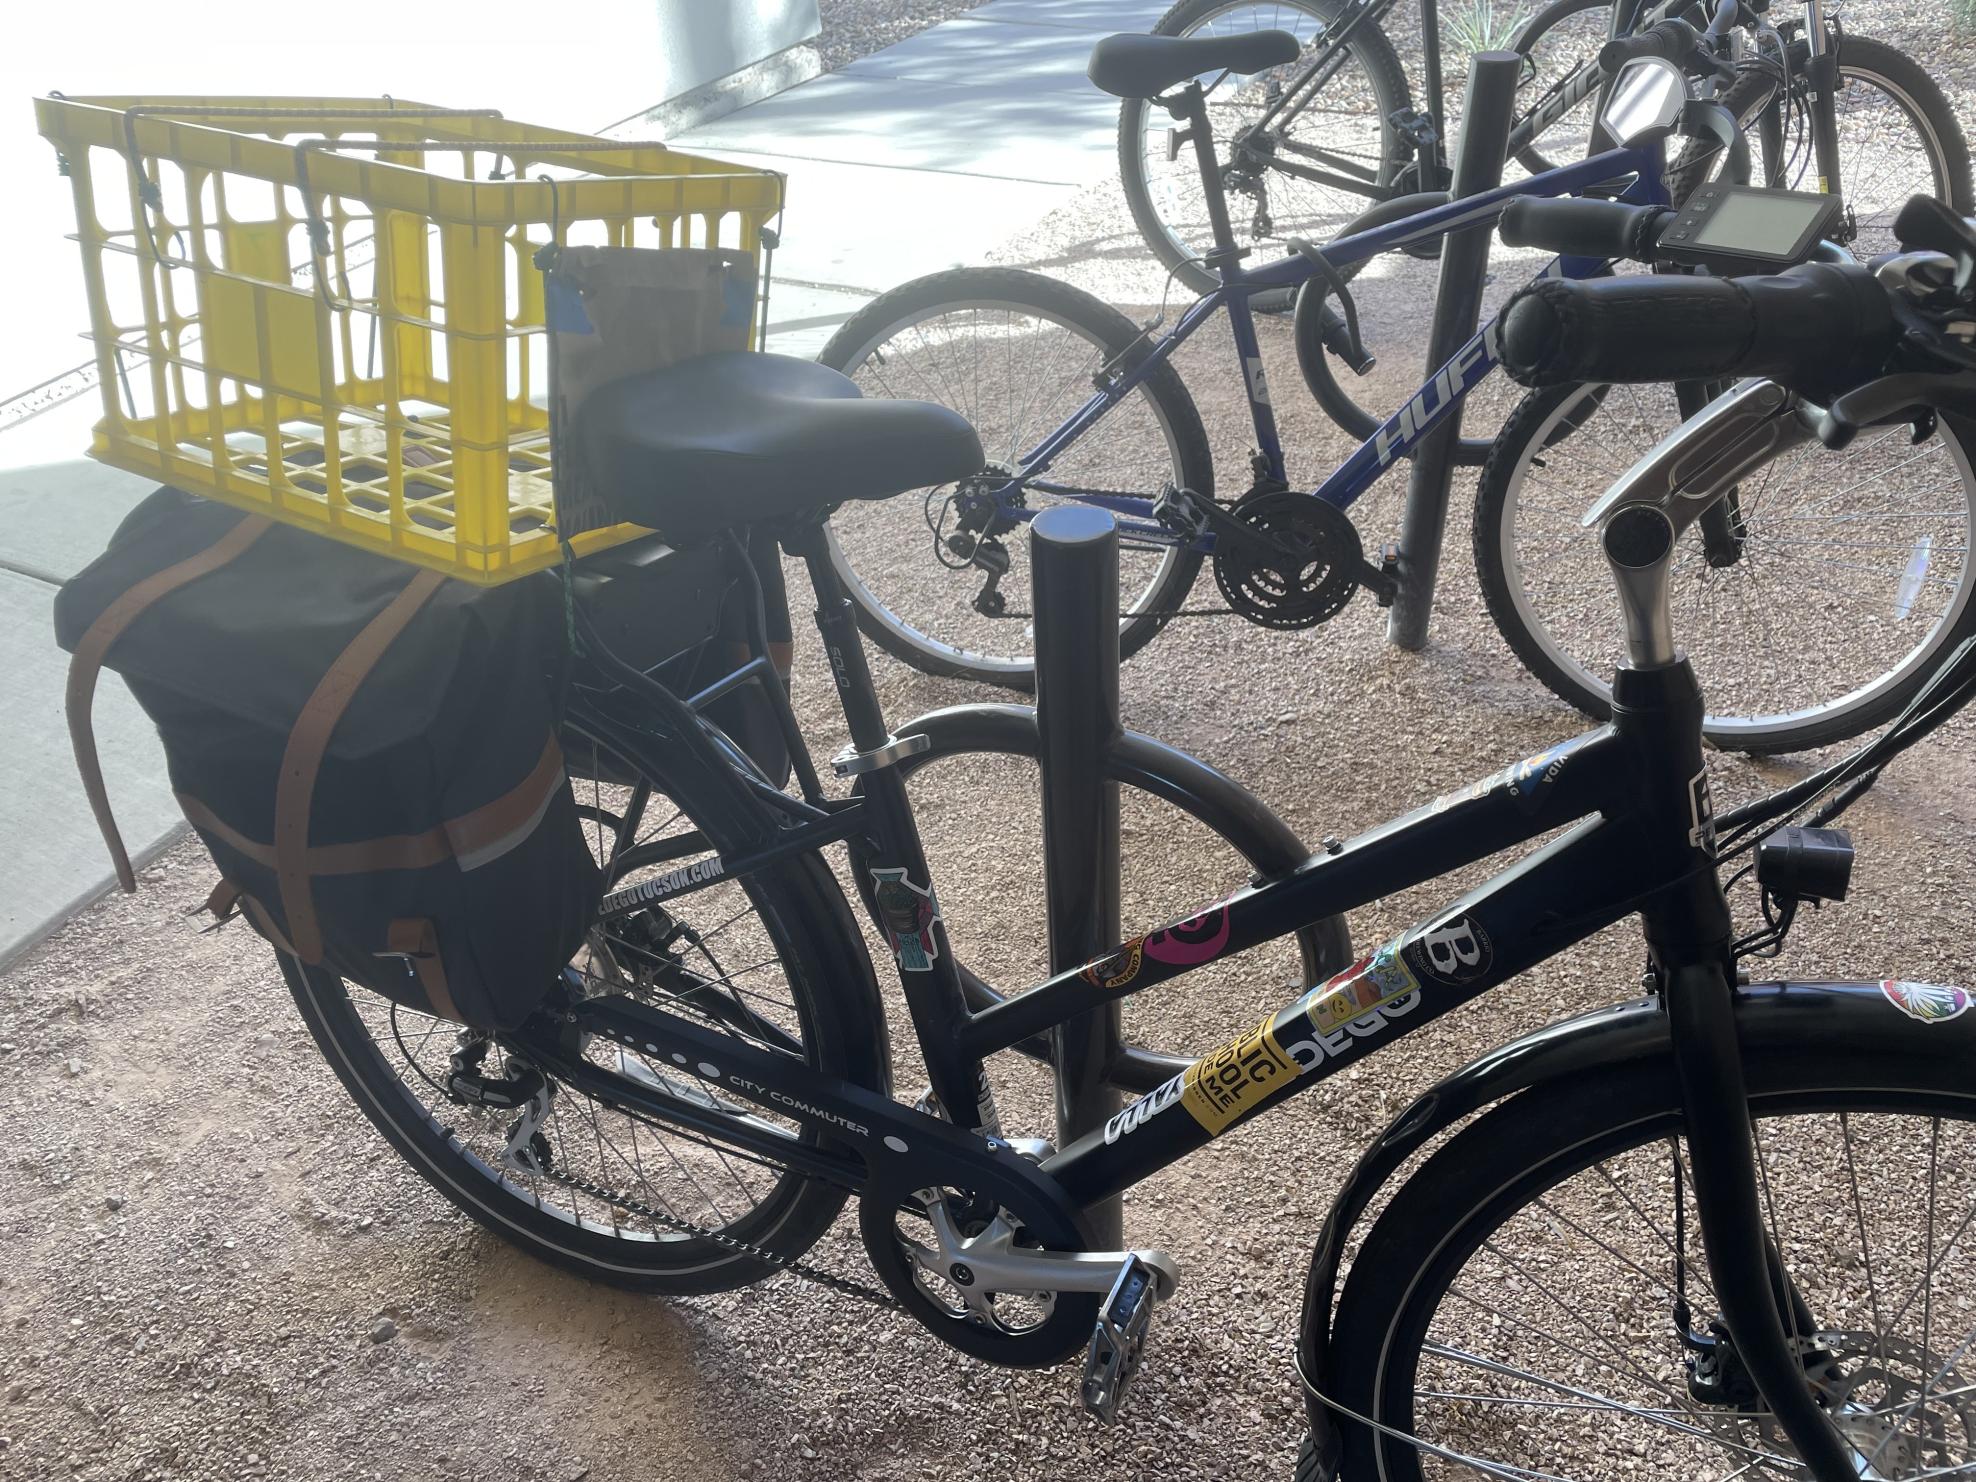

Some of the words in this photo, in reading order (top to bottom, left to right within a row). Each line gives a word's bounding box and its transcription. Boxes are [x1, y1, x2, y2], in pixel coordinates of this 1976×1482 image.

[1542, 755, 1569, 784] VIDA
[1110, 953, 1140, 986] COMPANY
[1424, 919, 1481, 975] B
[1236, 1024, 1277, 1083] BLIC
[729, 1075, 766, 1095] CITY
[769, 1091, 869, 1137] COMMUTER
[1205, 1075, 1236, 1109] ME
